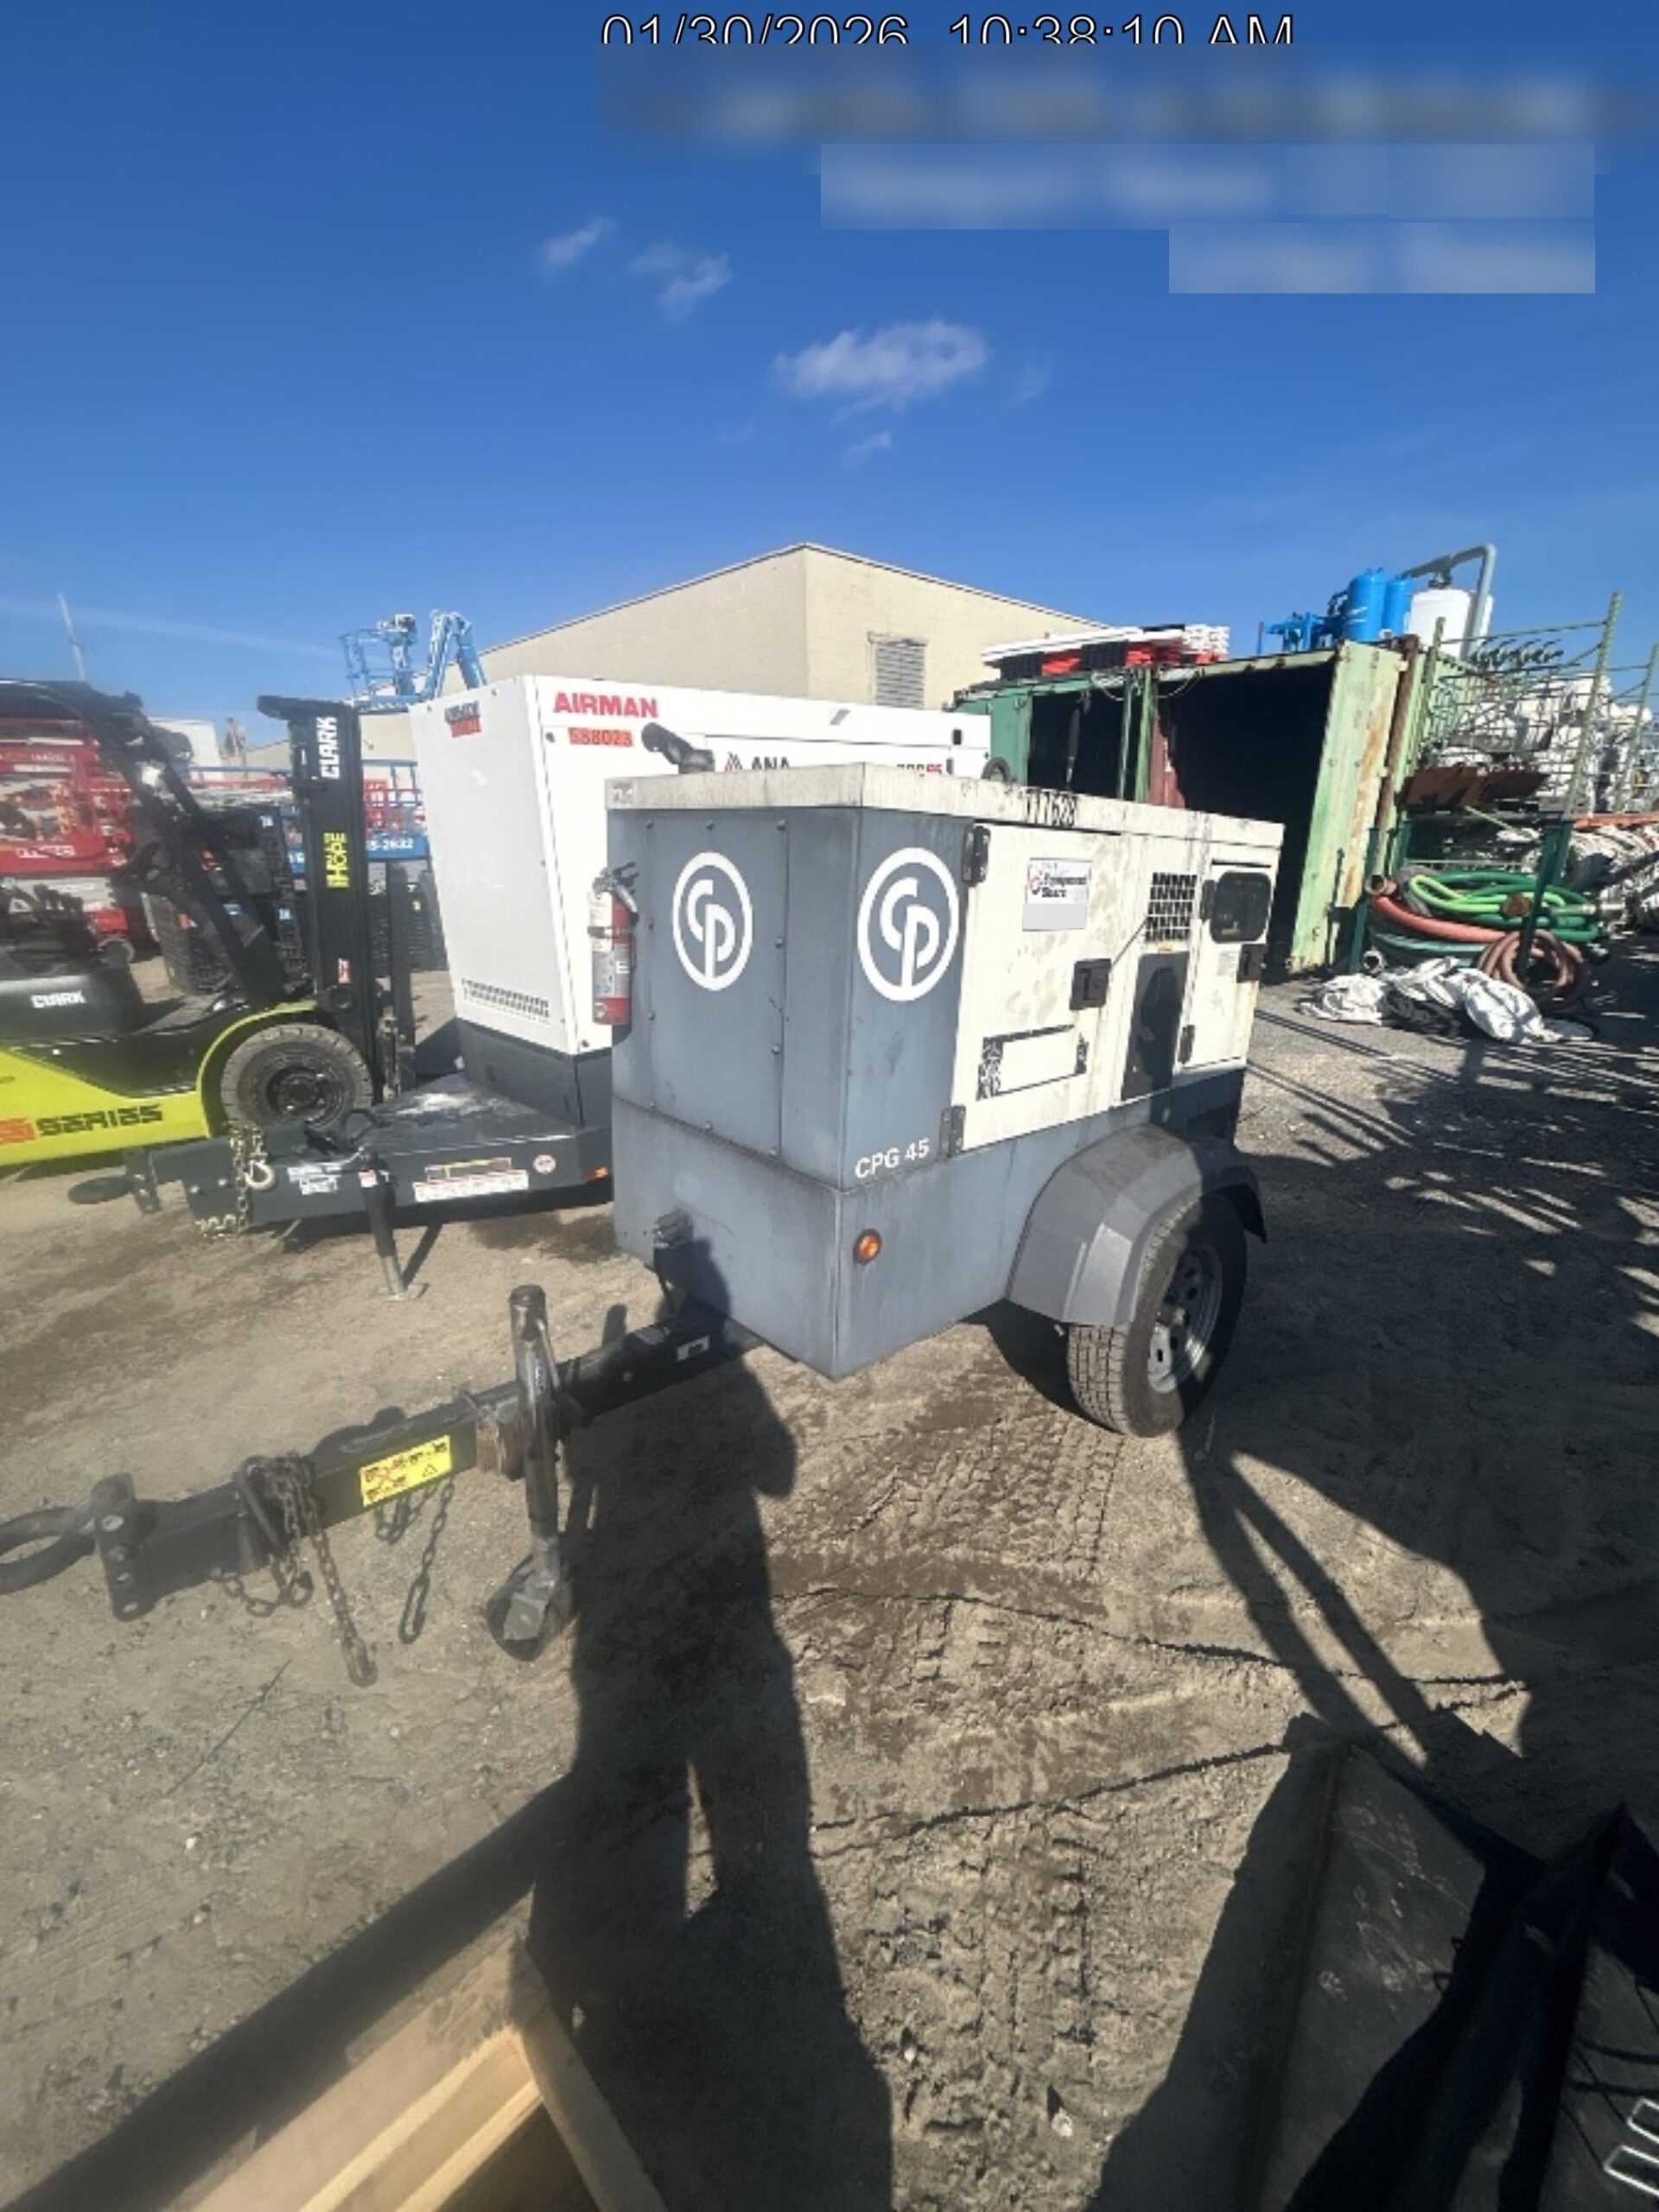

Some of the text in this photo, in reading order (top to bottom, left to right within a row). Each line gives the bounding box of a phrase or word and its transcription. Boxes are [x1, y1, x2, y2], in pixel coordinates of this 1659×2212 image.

[553, 692, 659, 718] AIRMAN
[316, 716, 340, 780] CLARK
[31, 990, 86, 1009] CLARK
[36, 1103, 162, 1137] SERIES
[854, 1136, 931, 1179] CPG 45
